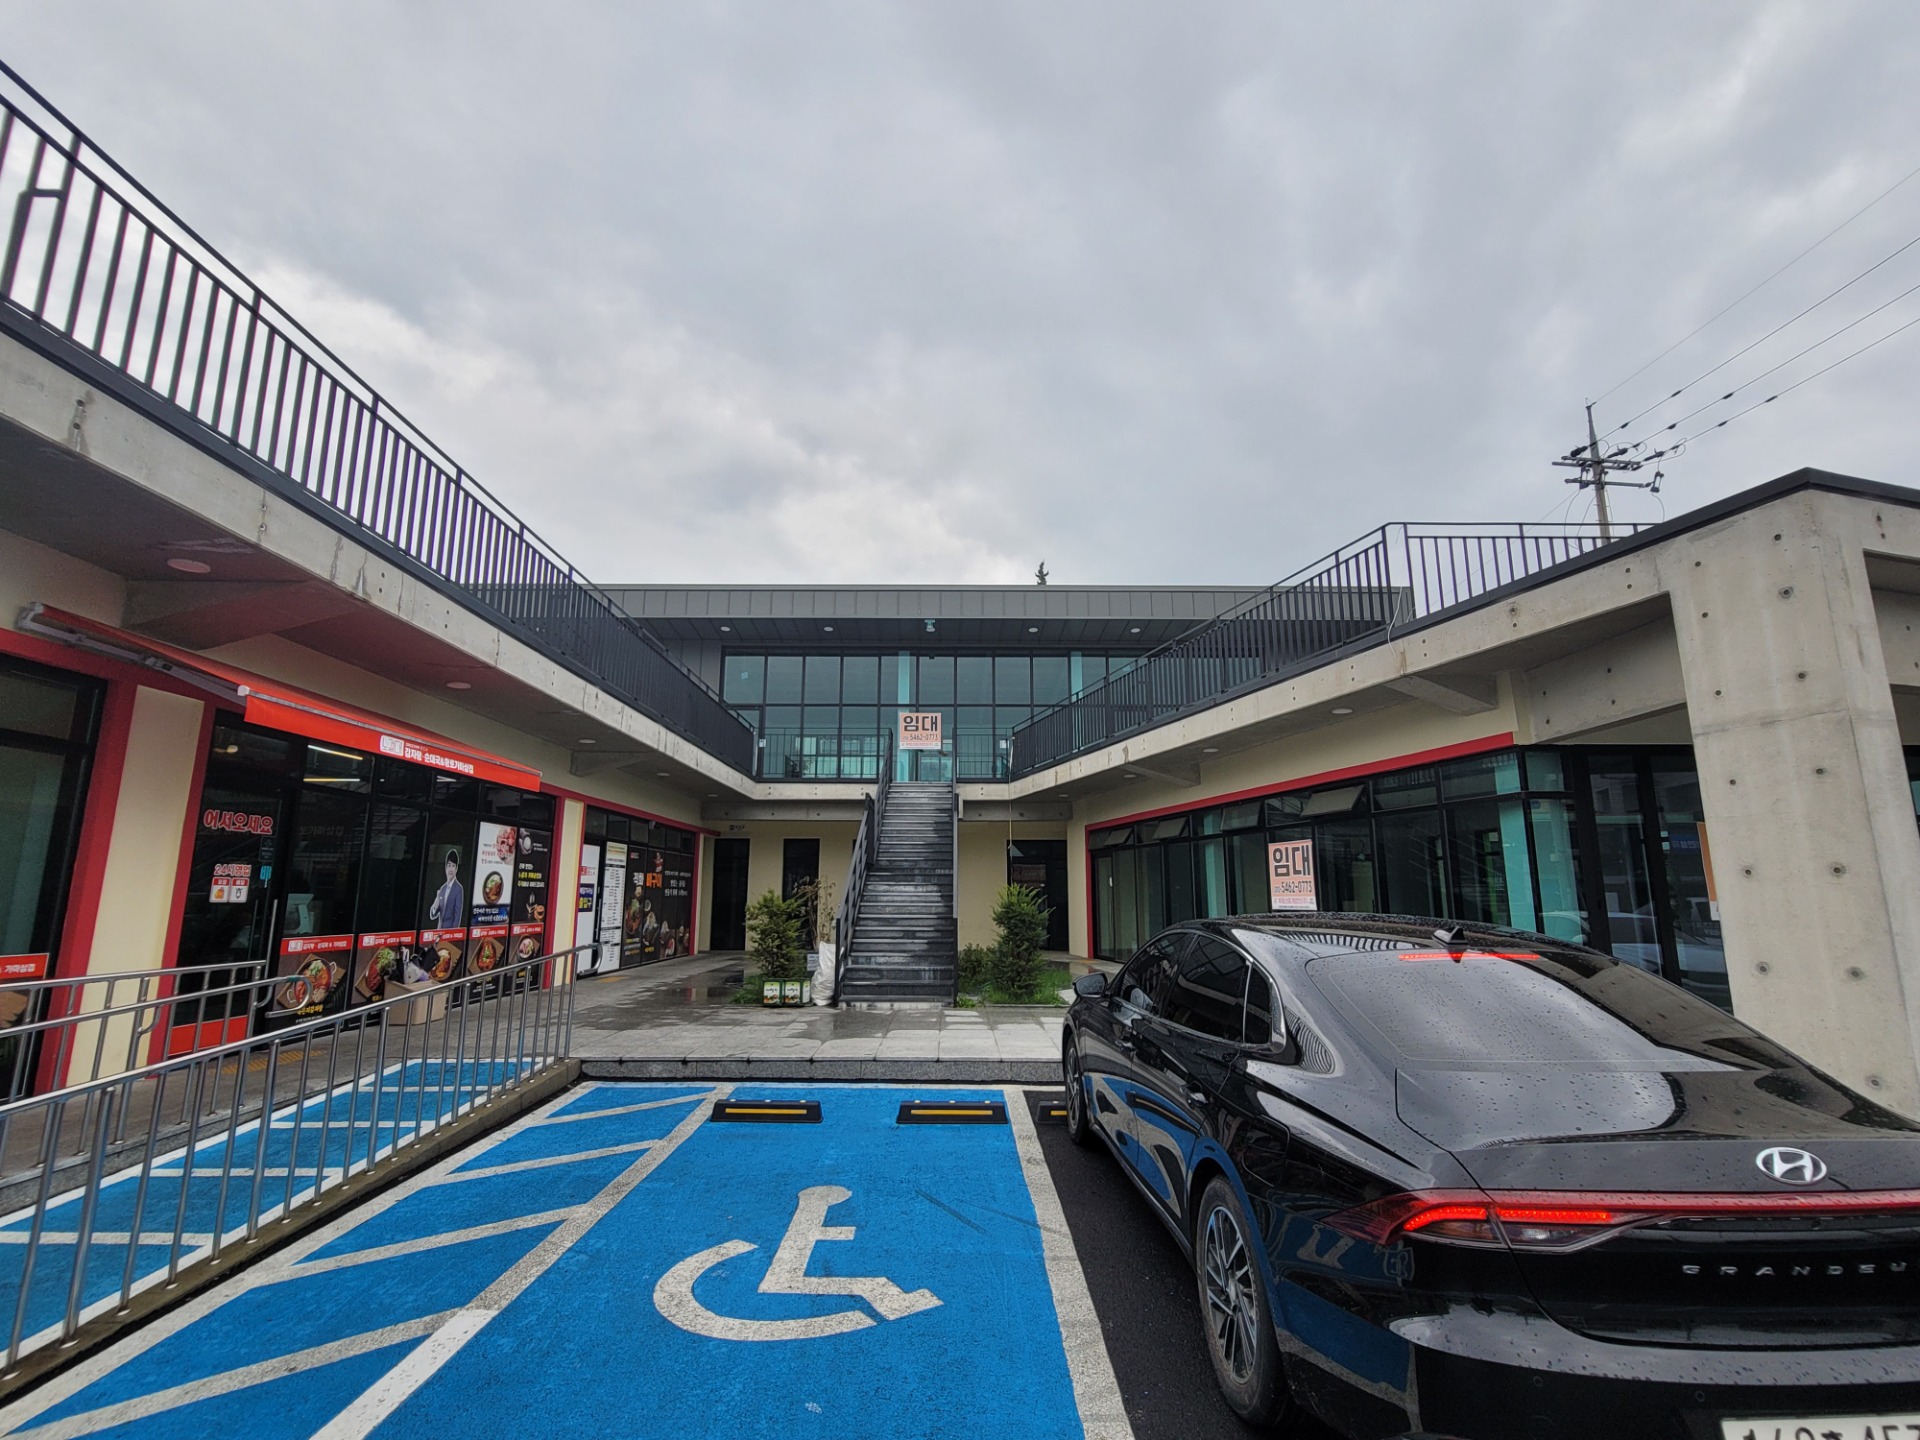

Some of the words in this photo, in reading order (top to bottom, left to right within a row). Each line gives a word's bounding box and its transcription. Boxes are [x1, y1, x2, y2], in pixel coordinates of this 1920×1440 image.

[903, 715, 938, 732] 임대
[909, 733, 938, 741] 5462-0773
[405, 747, 423, 761] 감자탕
[203, 809, 274, 835] 어서오세요
[1272, 844, 1311, 877] 임대
[213, 863, 252, 877] 24시영업
[1281, 880, 1312, 893] 5462-0773
